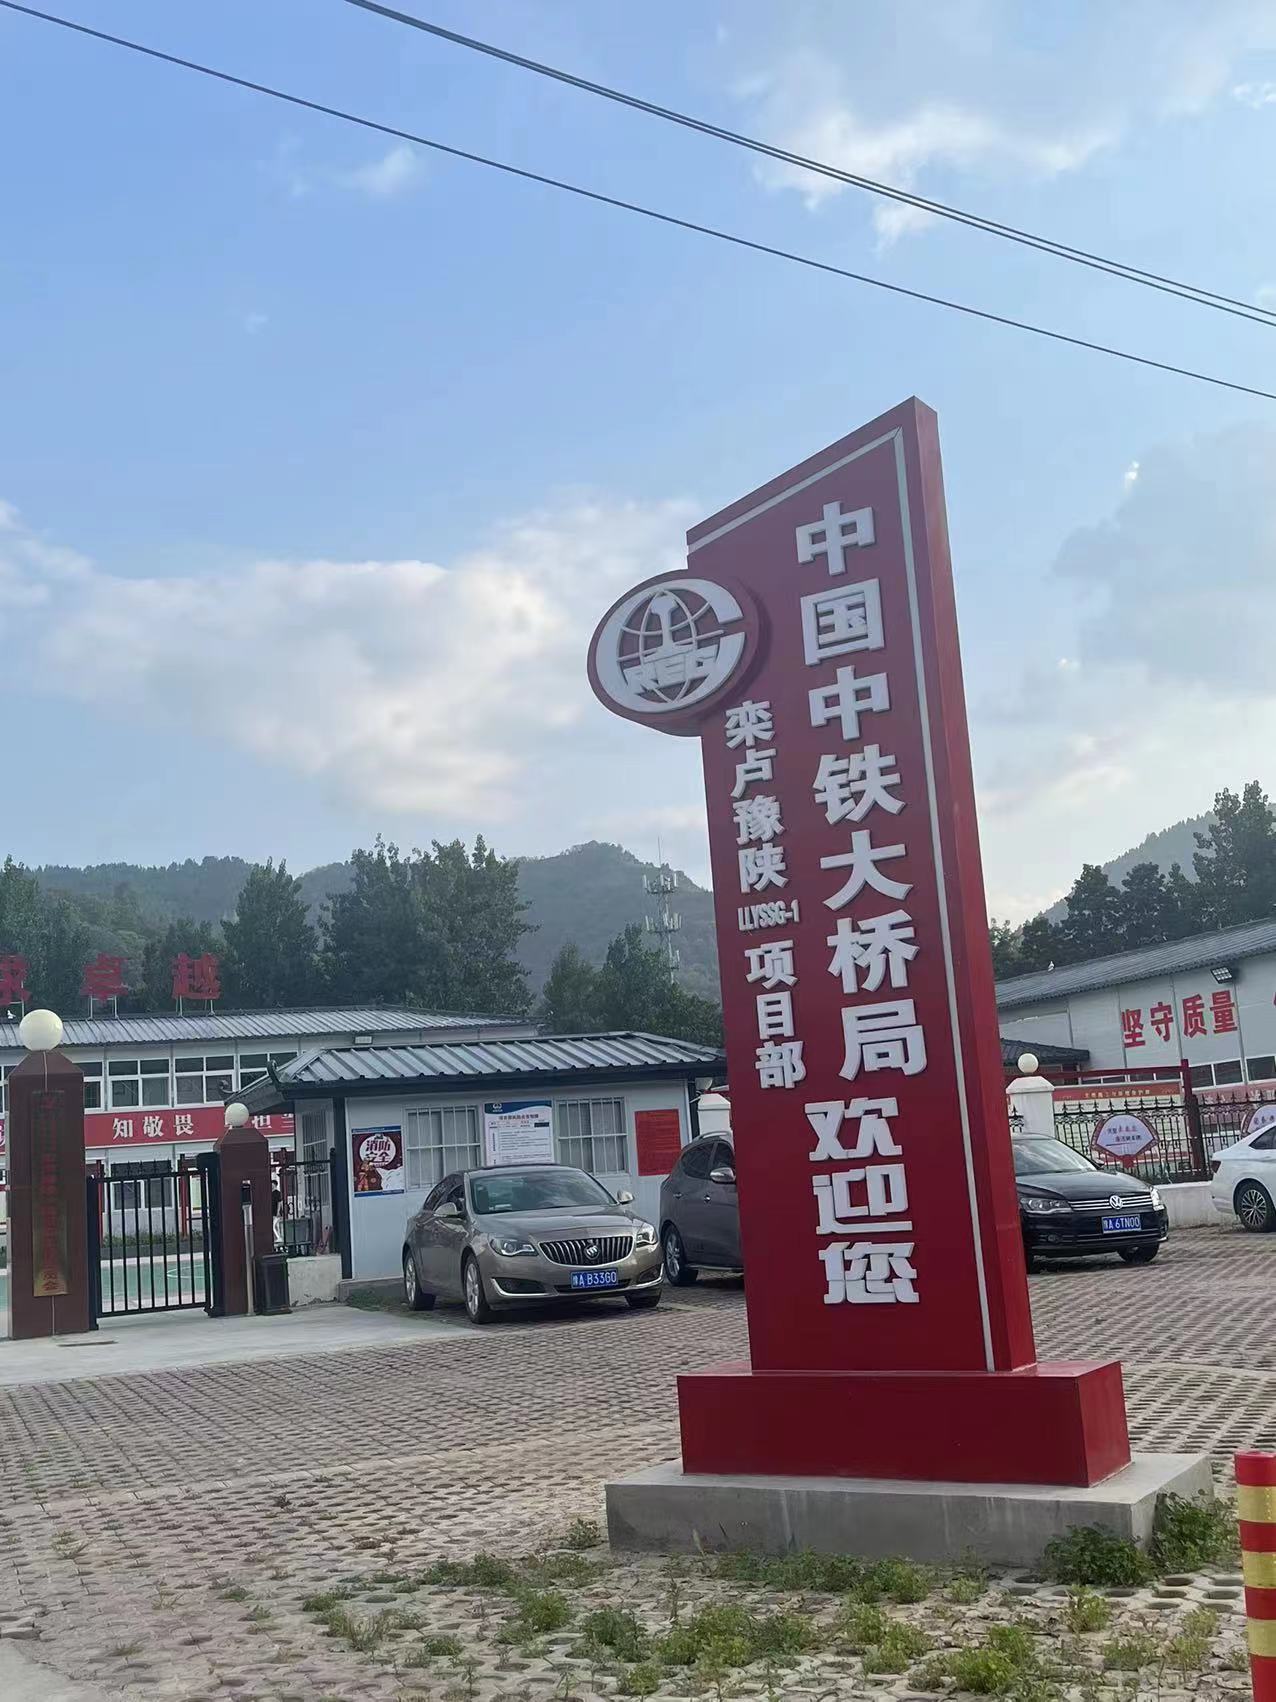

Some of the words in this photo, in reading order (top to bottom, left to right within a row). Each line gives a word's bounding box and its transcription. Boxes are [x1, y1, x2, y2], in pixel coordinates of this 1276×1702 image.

[724, 700, 789, 893] 栾卢豫陕
[795, 500, 928, 1081] 中国中铁大桥局
[737, 899, 800, 931] LLYSSG-1
[744, 940, 806, 1089] 项目部
[1121, 990, 1238, 1048] 坚守质量
[112, 1114, 194, 1140] 知敬畏
[365, 1139, 391, 1152] 消防
[804, 1097, 920, 1304] 欢迎您
